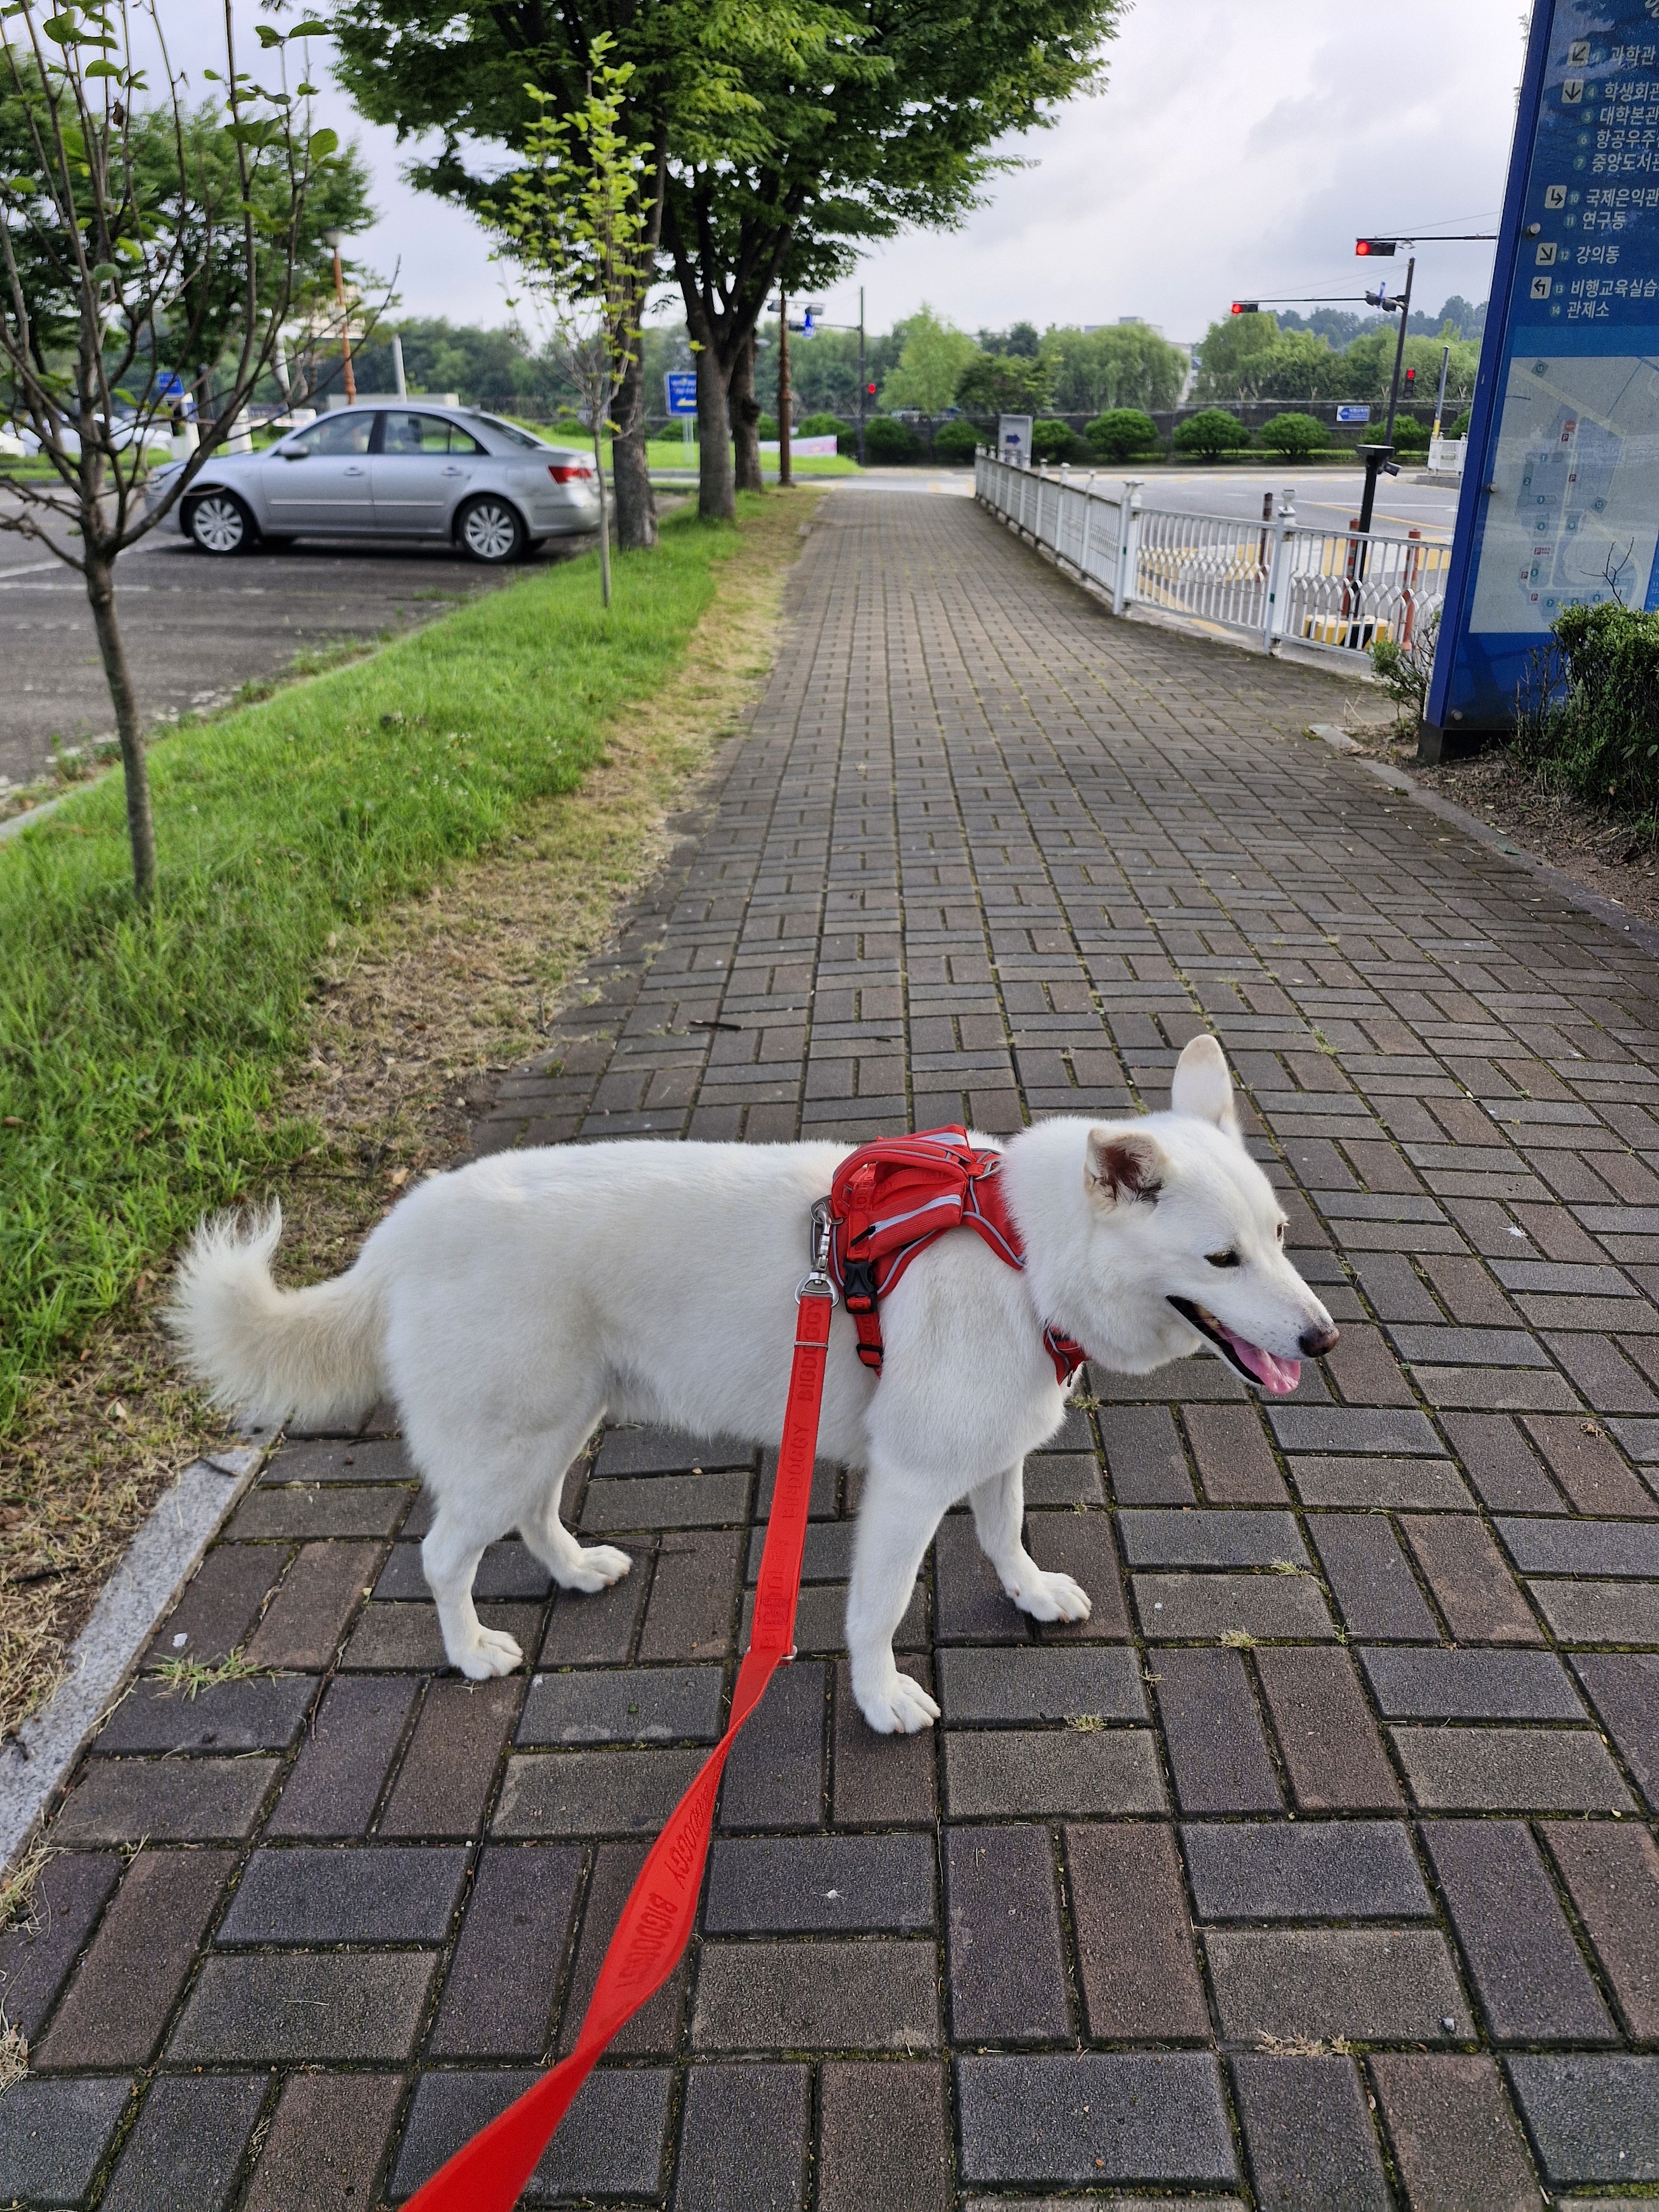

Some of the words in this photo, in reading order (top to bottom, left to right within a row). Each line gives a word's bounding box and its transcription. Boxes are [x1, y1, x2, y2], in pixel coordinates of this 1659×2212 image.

[1610, 44, 1656, 65] 과학관
[1588, 86, 1594, 97] 4
[1585, 112, 1591, 122] 5
[1600, 105, 1659, 126] 대학본관
[1580, 135, 1587, 145] 6
[1597, 129, 1659, 149] 항공우주
[1577, 158, 1583, 168] 7
[1587, 188, 1659, 207] 국제은익관
[1567, 217, 1574, 226] 11
[1583, 211, 1626, 230] 연구동
[1561, 251, 1569, 260] 12
[1577, 246, 1620, 264] 강의동
[1556, 284, 1564, 294] 13
[1571, 278, 1659, 298] 비행교육실습
[1552, 306, 1560, 315] 14
[1567, 300, 1610, 319] 관제소
